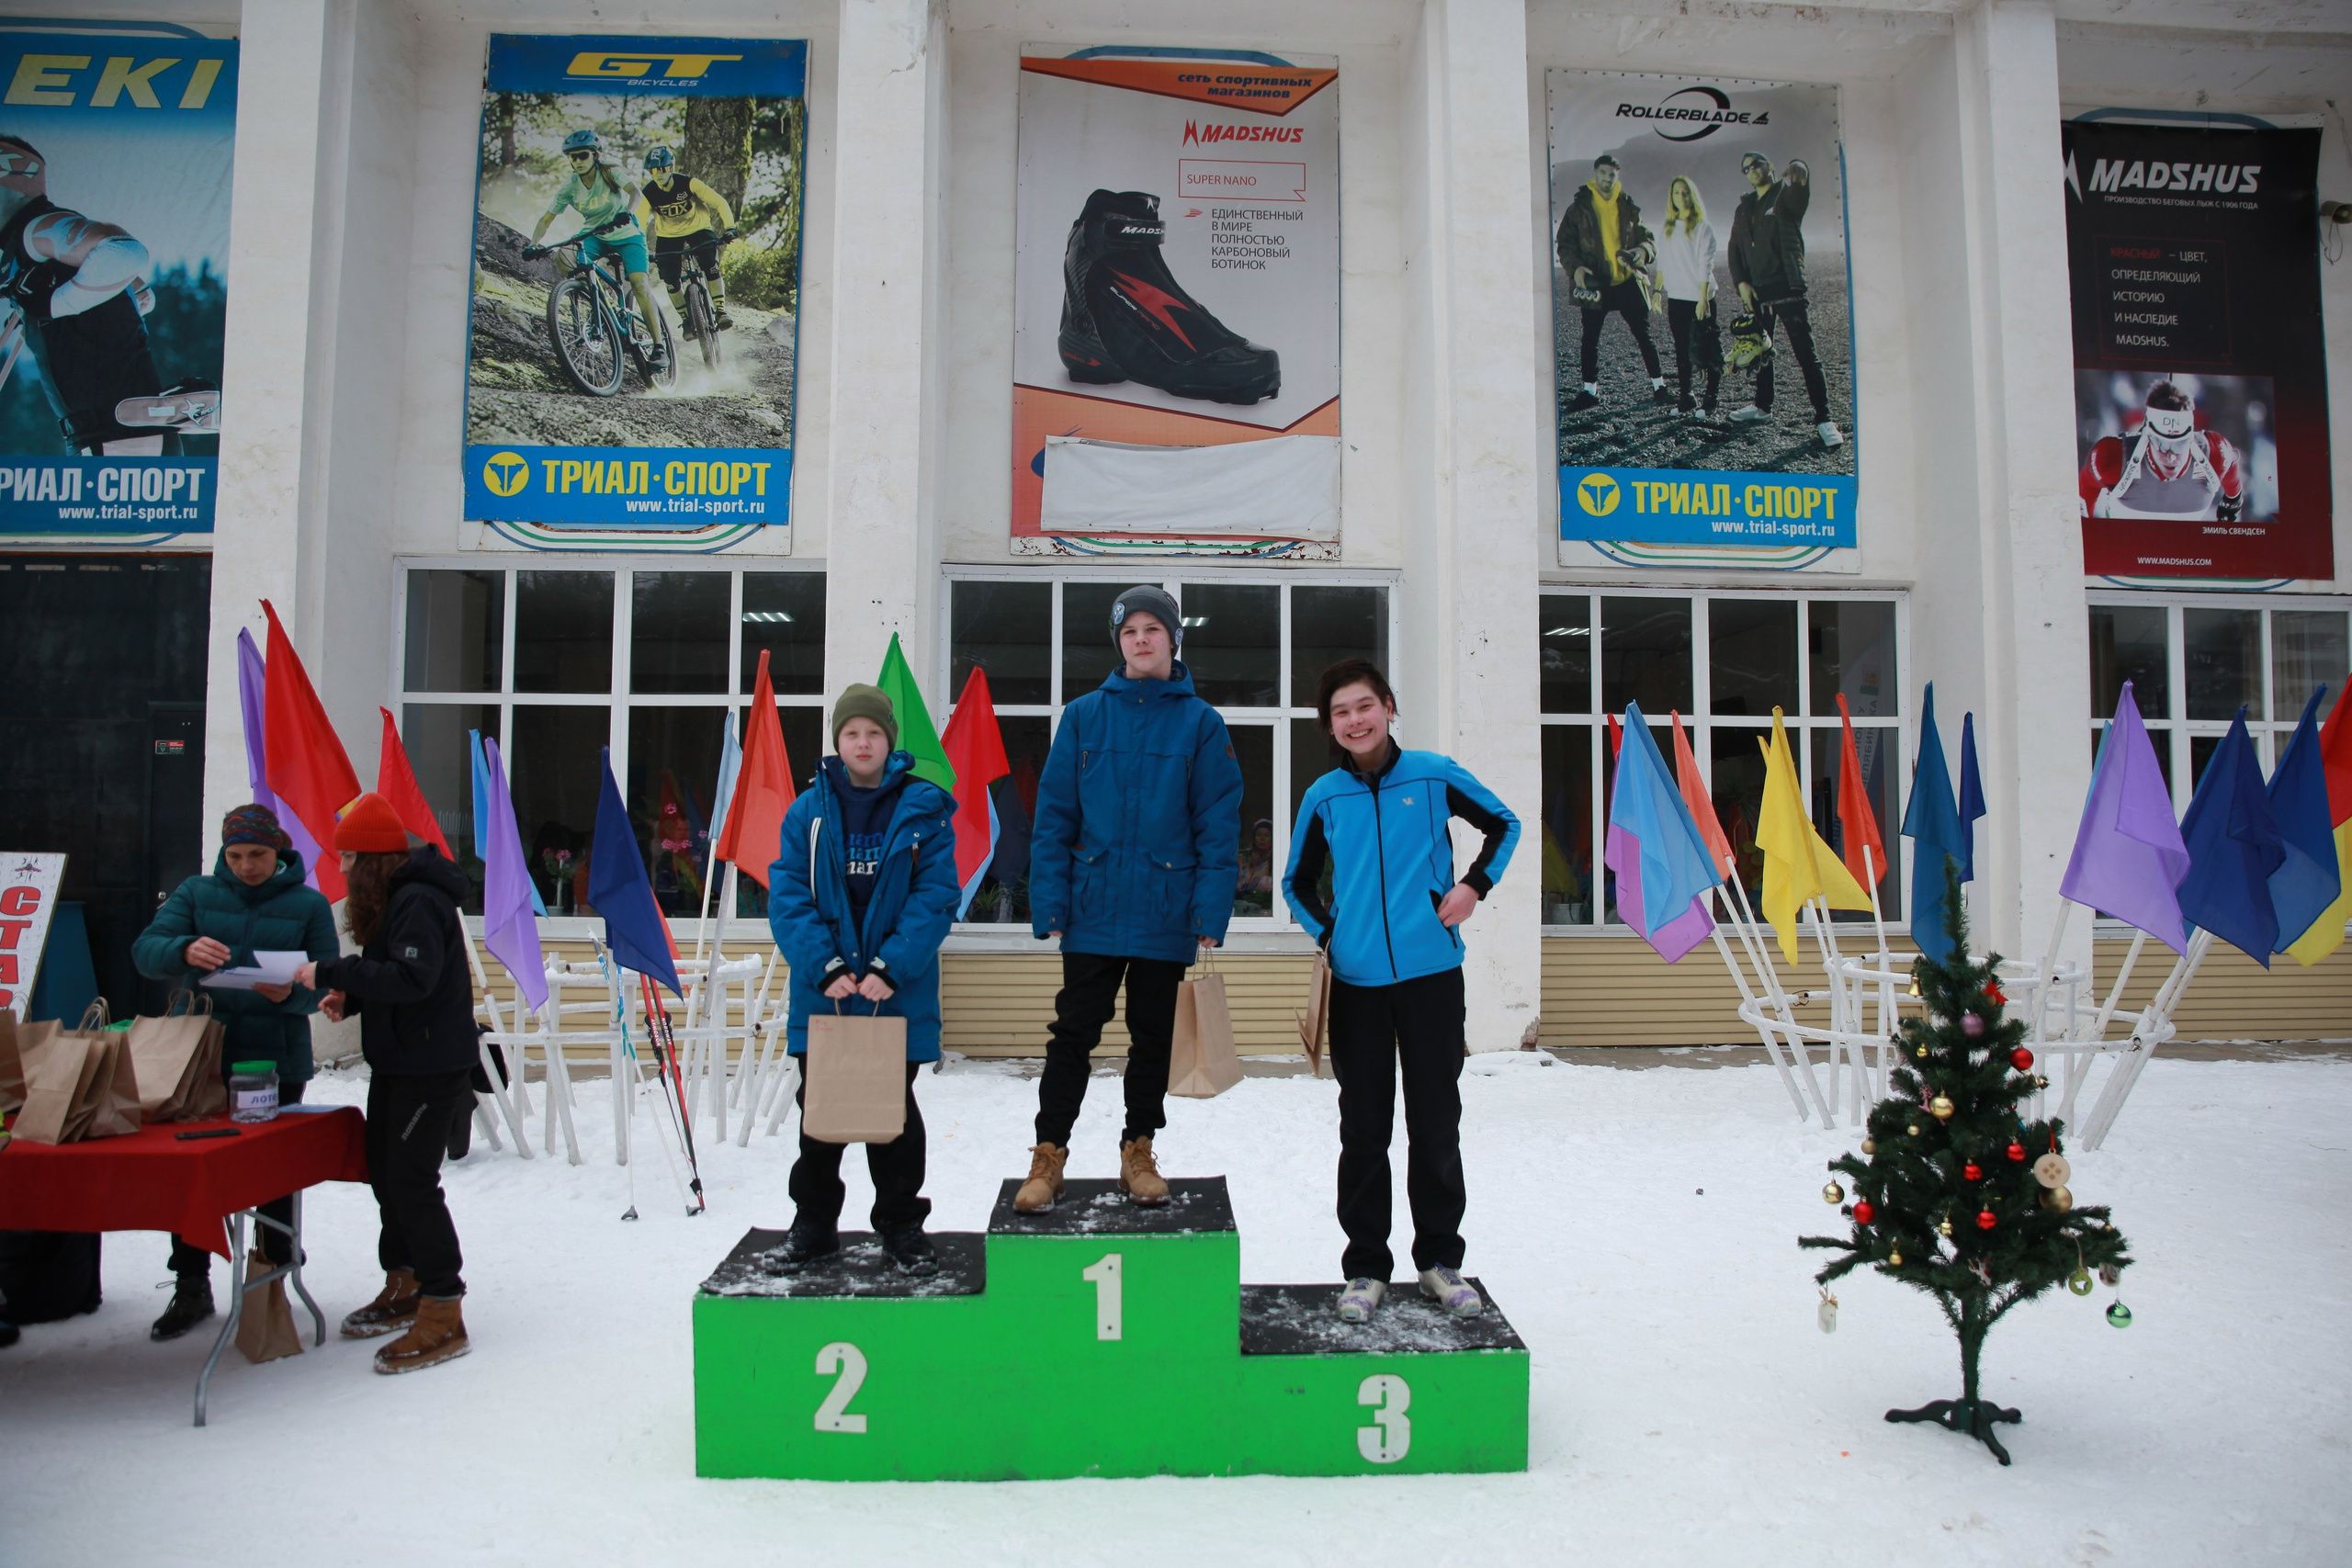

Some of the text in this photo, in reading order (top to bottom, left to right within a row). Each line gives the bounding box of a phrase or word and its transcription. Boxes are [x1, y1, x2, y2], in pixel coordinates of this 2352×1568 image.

[566, 52, 743, 77] GT
[1178, 74, 1312, 87] сеть спортивных
[1207, 86, 1290, 98] магазинов
[1615, 103, 1751, 124] ROLLERBLADE
[1200, 124, 1304, 143] MADSHUS
[1187, 175, 1257, 186] SUPER NANO
[2088, 158, 2262, 194] MADSHUS
[2104, 195, 2162, 206] ПРОИЗВОДСТВО
[2163, 197, 2195, 207] БЕГОВЫХ
[2197, 199, 2214, 208] ЛЫЖ
[2222, 201, 2238, 209] 1906
[2239, 201, 2258, 210] ГОДА
[661, 203, 688, 218] FOX
[1212, 209, 1303, 220] ЕДИНСТВЕННЫЙ
[1212, 221, 1252, 231] В МИРЕ
[1212, 234, 1284, 245] ПОЛНОСТЬЮ
[1212, 246, 1290, 258] КАРБОНОВЫЙ
[2110, 247, 2160, 258] КРАСНЫЙ
[2180, 251, 2207, 263] ЦВЕТ,
[1212, 259, 1266, 270] БОТИНОК
[2111, 269, 2200, 283] ОПРЕДЕЛЯЮЩИЙ
[2113, 291, 2165, 302] ИСТОРИЮ
[2115, 312, 2178, 325] И НАСЛЕДИЕ
[2116, 334, 2169, 346] MADSHUS.
[59, 505, 198, 522] www.trial-sport.ru
[627, 499, 765, 515] www.trial-sport.ru
[1712, 520, 1836, 537] www.trial-sport.ru
[2202, 526, 2266, 536] ЭМИЛЬ СВЕНДСЕН
[2137, 557, 2211, 566] WWW.MADSHUS.COM
[651, 1019, 662, 1047] NORDWAY
[662, 1017, 673, 1045] NORDWAY
[1082, 1253, 1122, 1340] 1
[813, 1341, 867, 1433] 2
[1357, 1374, 1410, 1463] 3
